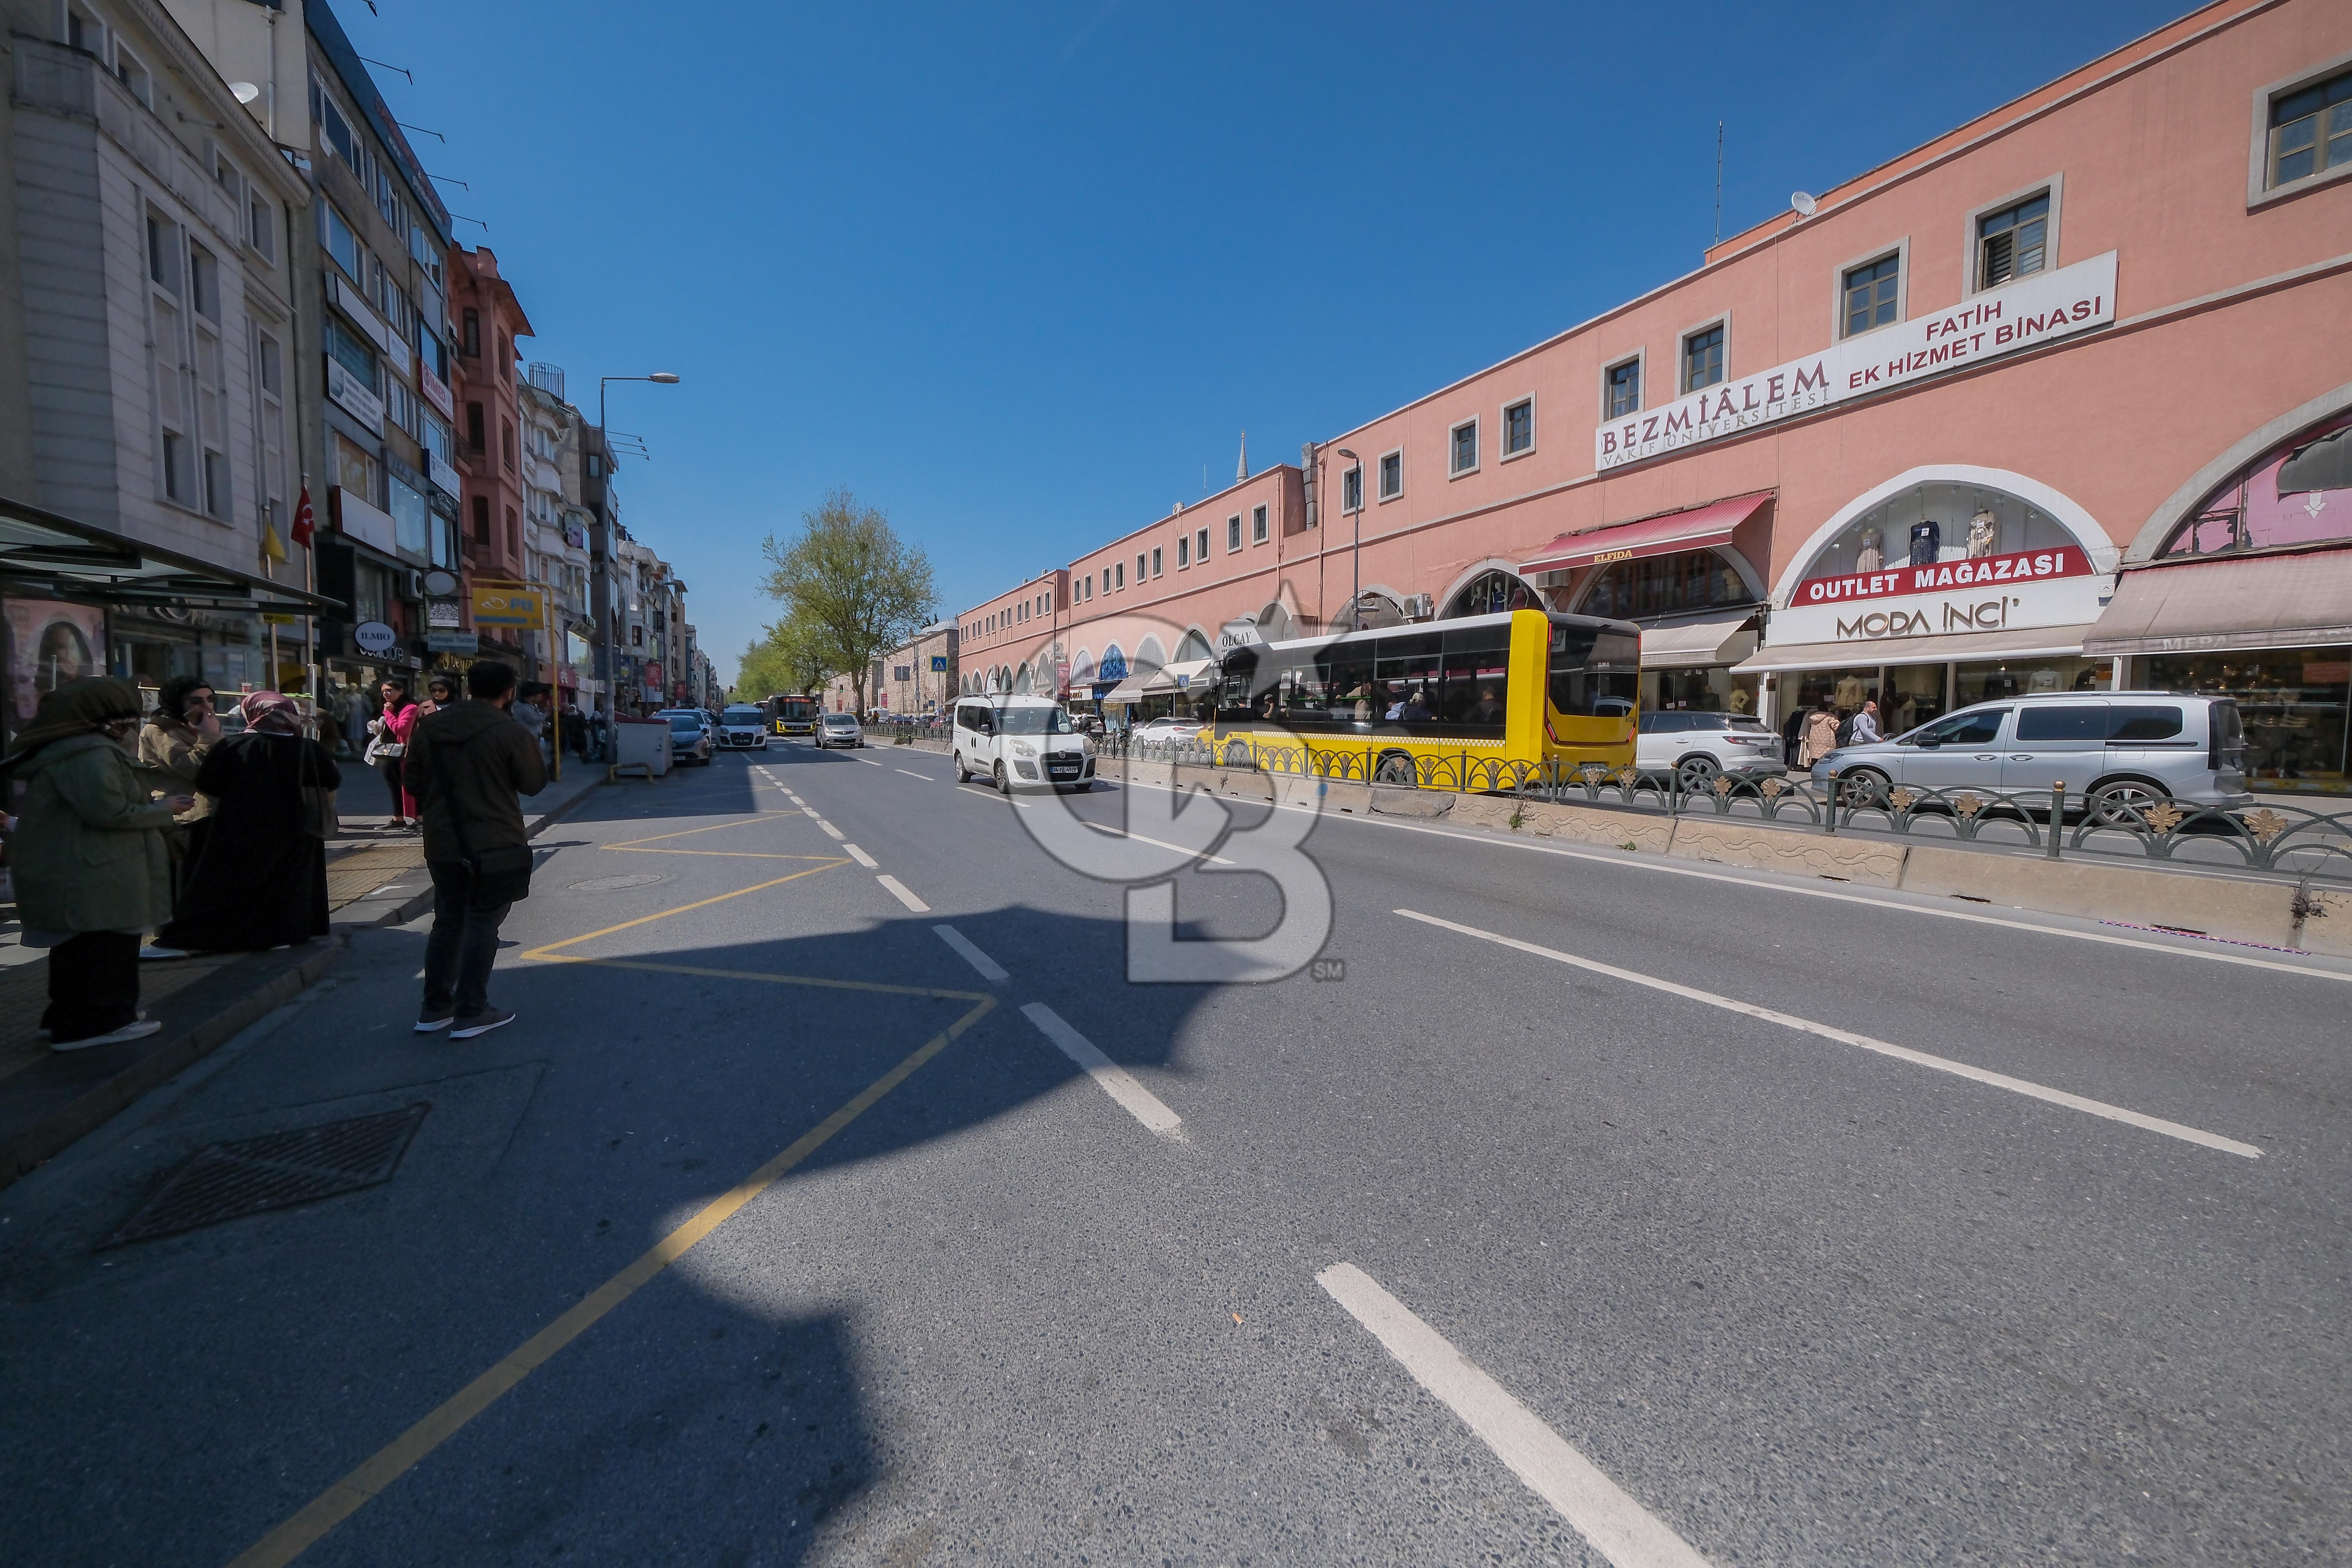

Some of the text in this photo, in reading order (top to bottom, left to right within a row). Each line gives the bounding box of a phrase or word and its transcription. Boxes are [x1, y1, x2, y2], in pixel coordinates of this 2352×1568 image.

[1849, 295, 2101, 390] EK HİZMET BİNASI
[1927, 300, 2002, 341] FATİH
[1603, 360, 1830, 455] BEZMİÂLEM
[1604, 387, 1828, 466] VAKIF ÜNİVERSİTESİ
[1809, 553, 2064, 600] OUTLET MAĞAZASI
[1222, 631, 1251, 647] OLCAY
[1837, 609, 1931, 640] MODA
